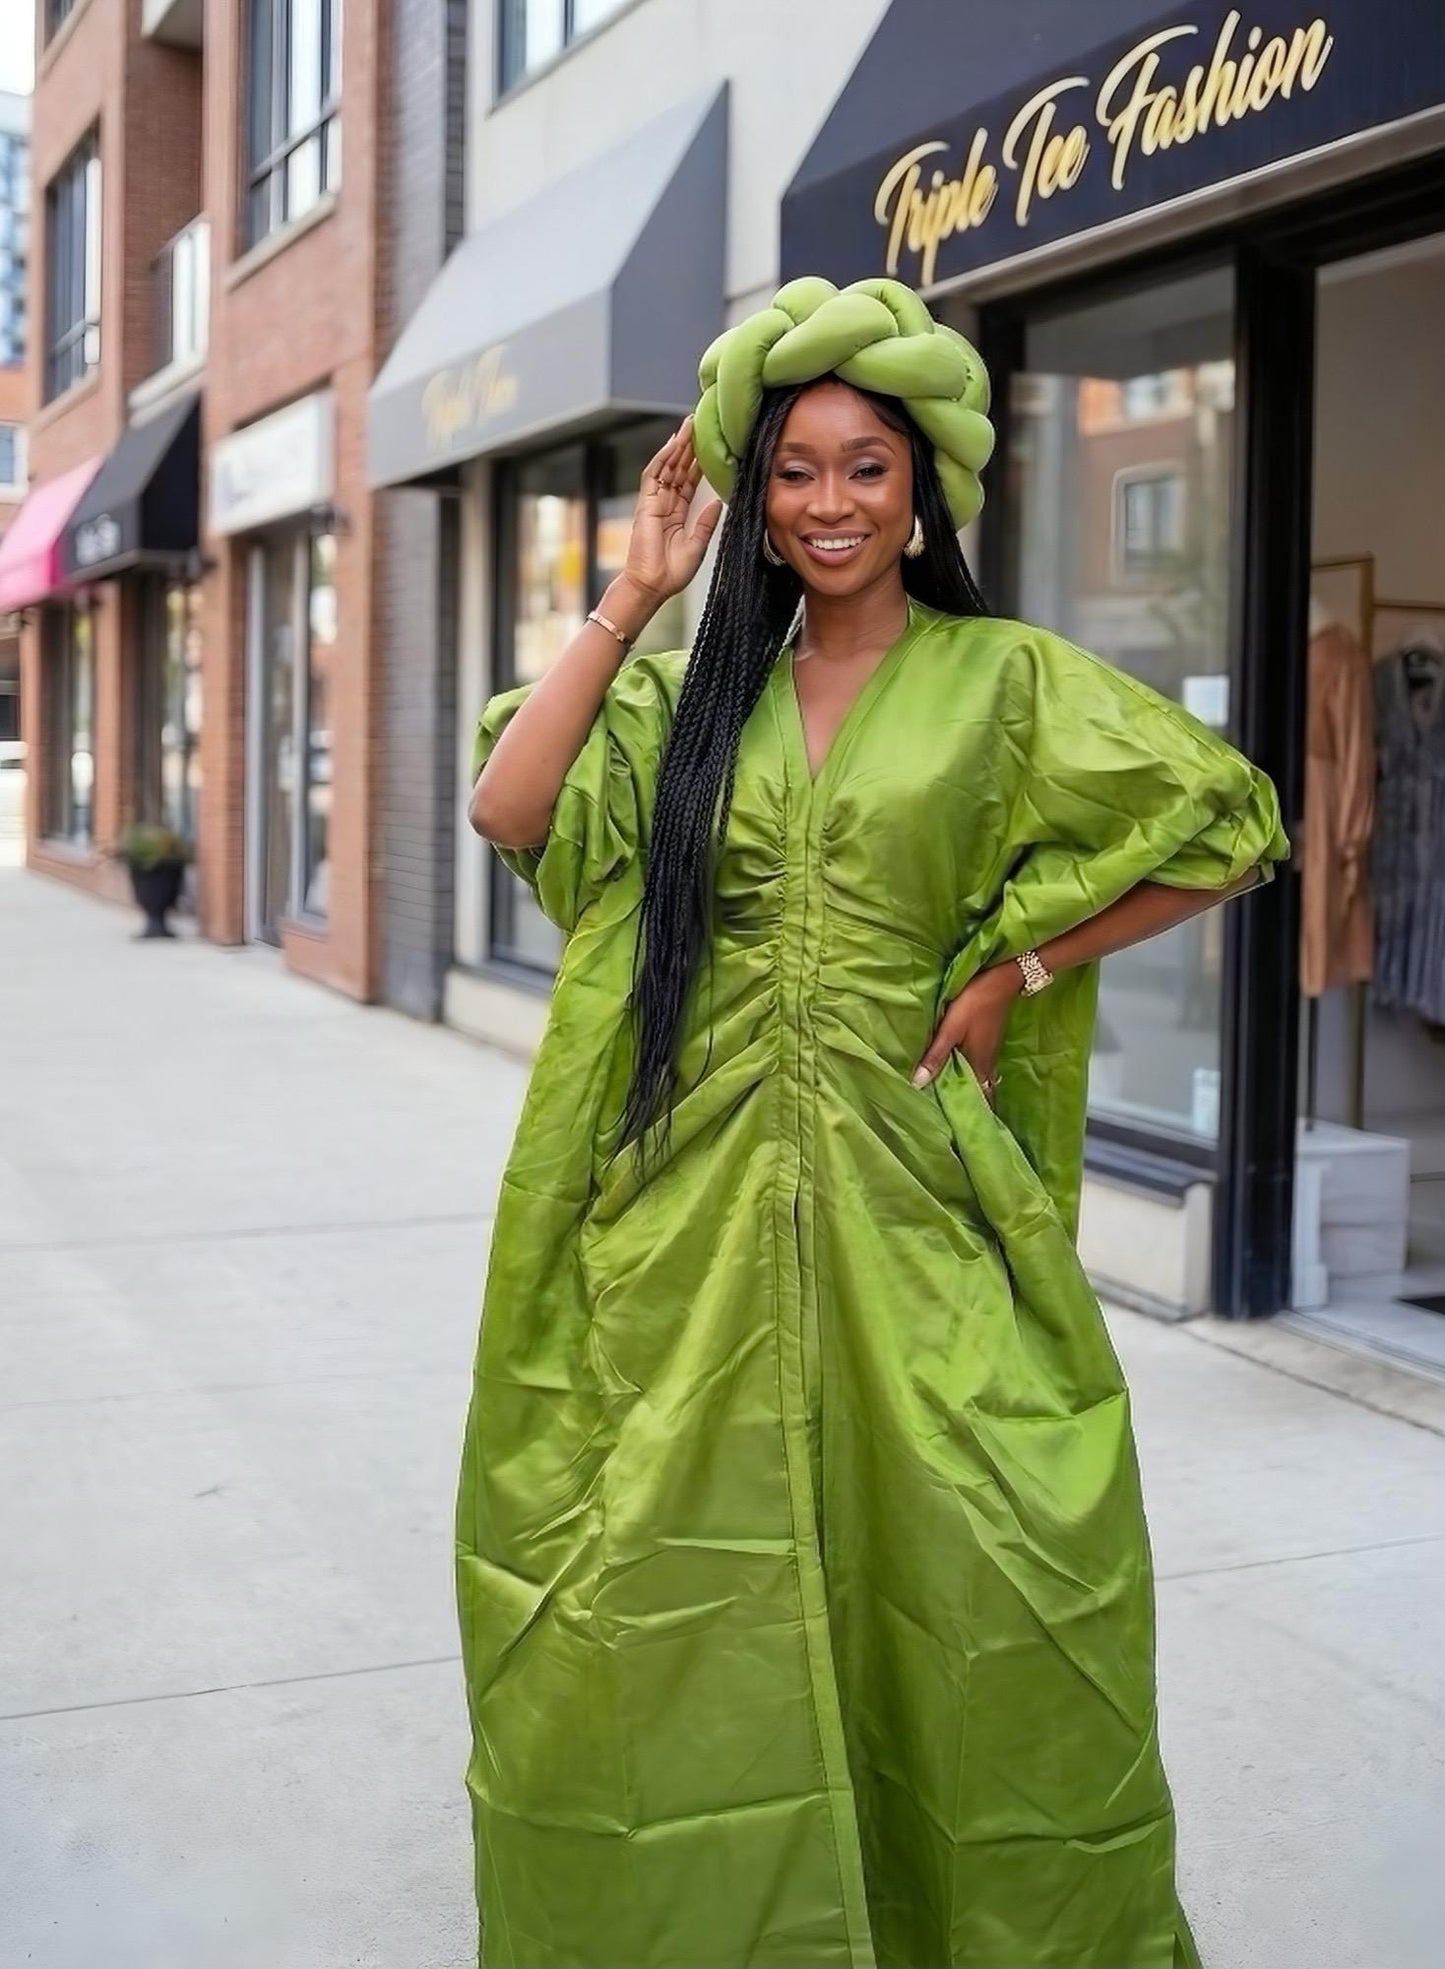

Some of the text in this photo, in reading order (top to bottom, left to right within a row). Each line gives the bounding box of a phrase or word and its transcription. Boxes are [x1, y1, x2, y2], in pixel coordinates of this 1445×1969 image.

[874, 10, 1334, 286] Triple Tee Fashion
